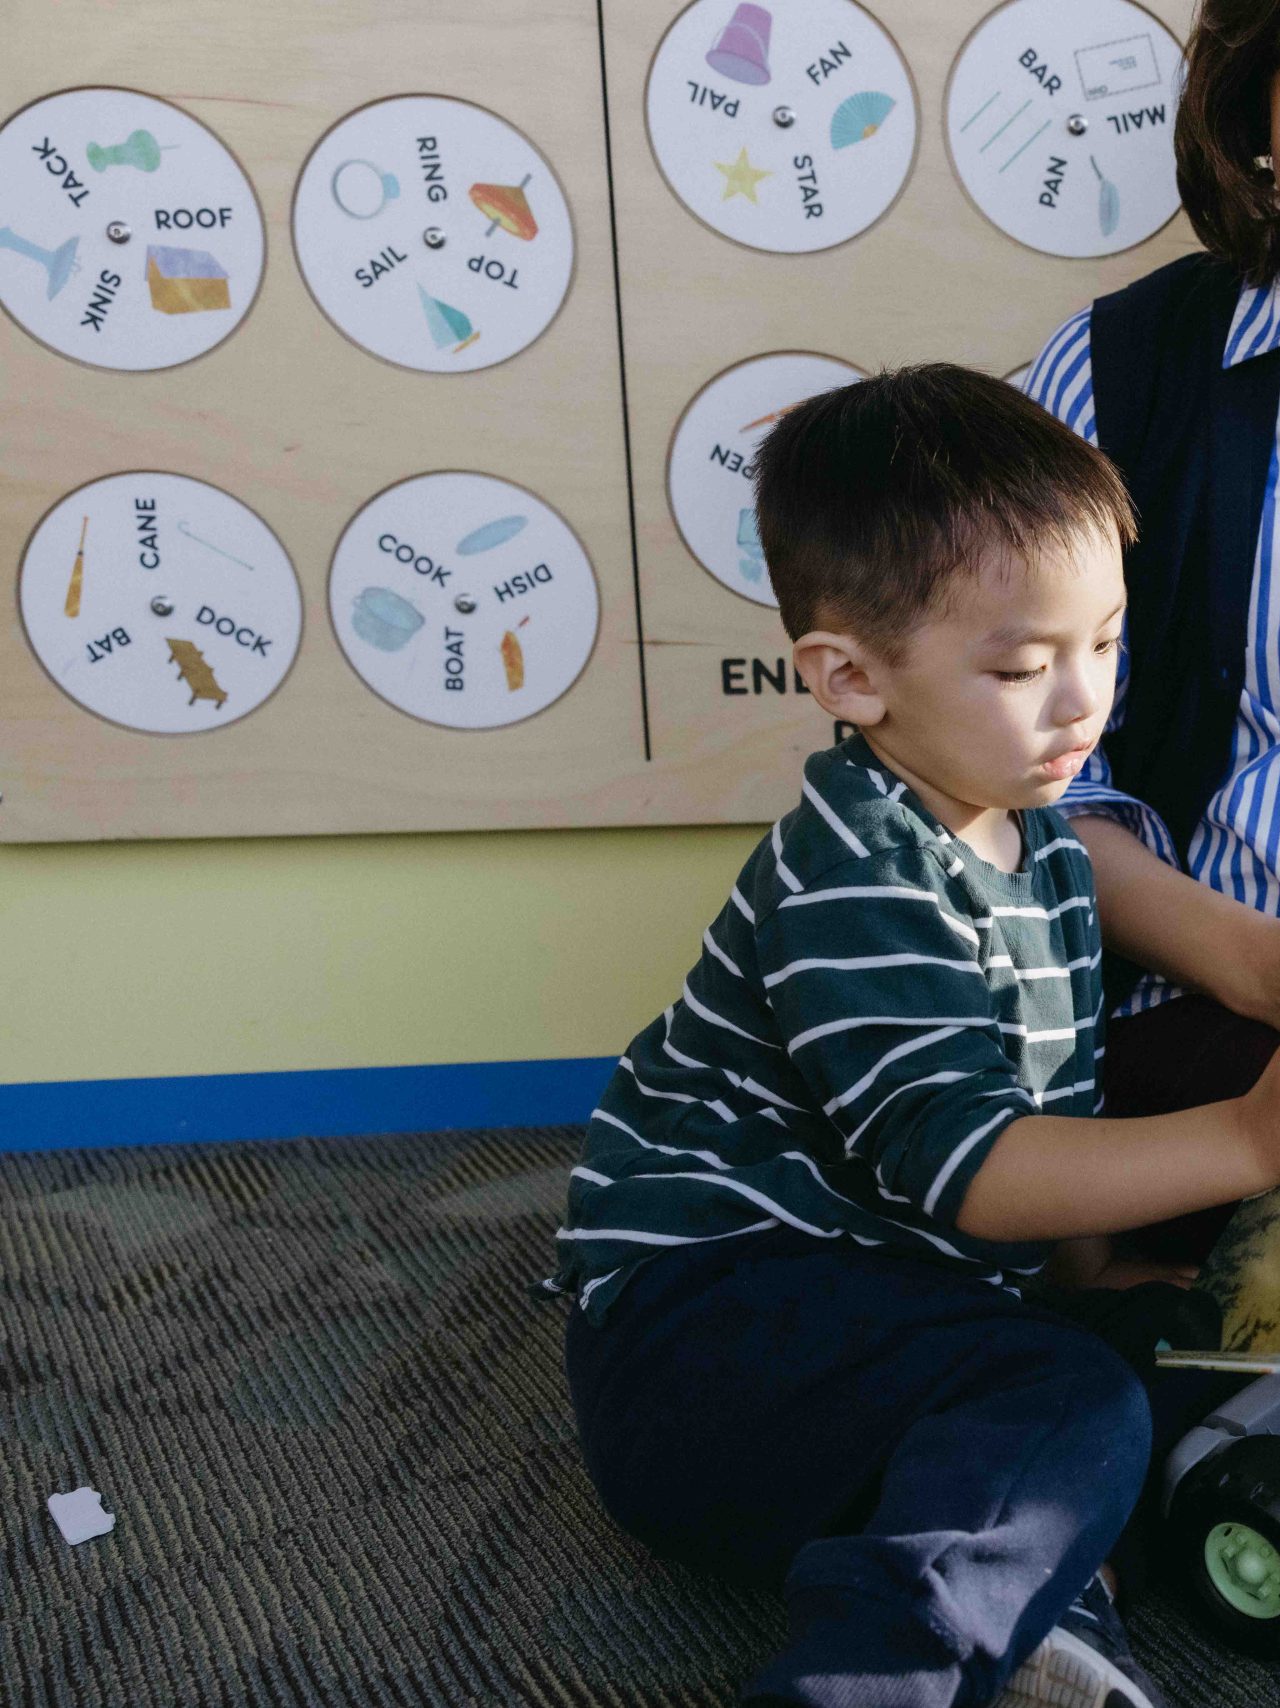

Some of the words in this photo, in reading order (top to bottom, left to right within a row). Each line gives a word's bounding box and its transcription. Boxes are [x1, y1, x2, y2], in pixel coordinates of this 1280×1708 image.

[806, 41, 852, 85] FAN
[1019, 48, 1061, 95] BAR
[688, 81, 740, 118] PAIL
[1107, 104, 1165, 134] MAIL
[32, 137, 89, 207] TACK
[417, 137, 447, 202] RING
[794, 155, 823, 219] STAR
[1039, 157, 1067, 208] PAN
[155, 208, 232, 229] ROOF
[355, 247, 407, 288] SAIL
[468, 256, 518, 289] TOP
[81, 270, 121, 332] SINK
[136, 499, 160, 569] CANE
[378, 534, 451, 587] COOK
[494, 564, 552, 602] DISH
[88, 627, 131, 663] BAT
[196, 606, 272, 656] DOCK
[445, 627, 464, 691] BOAT
